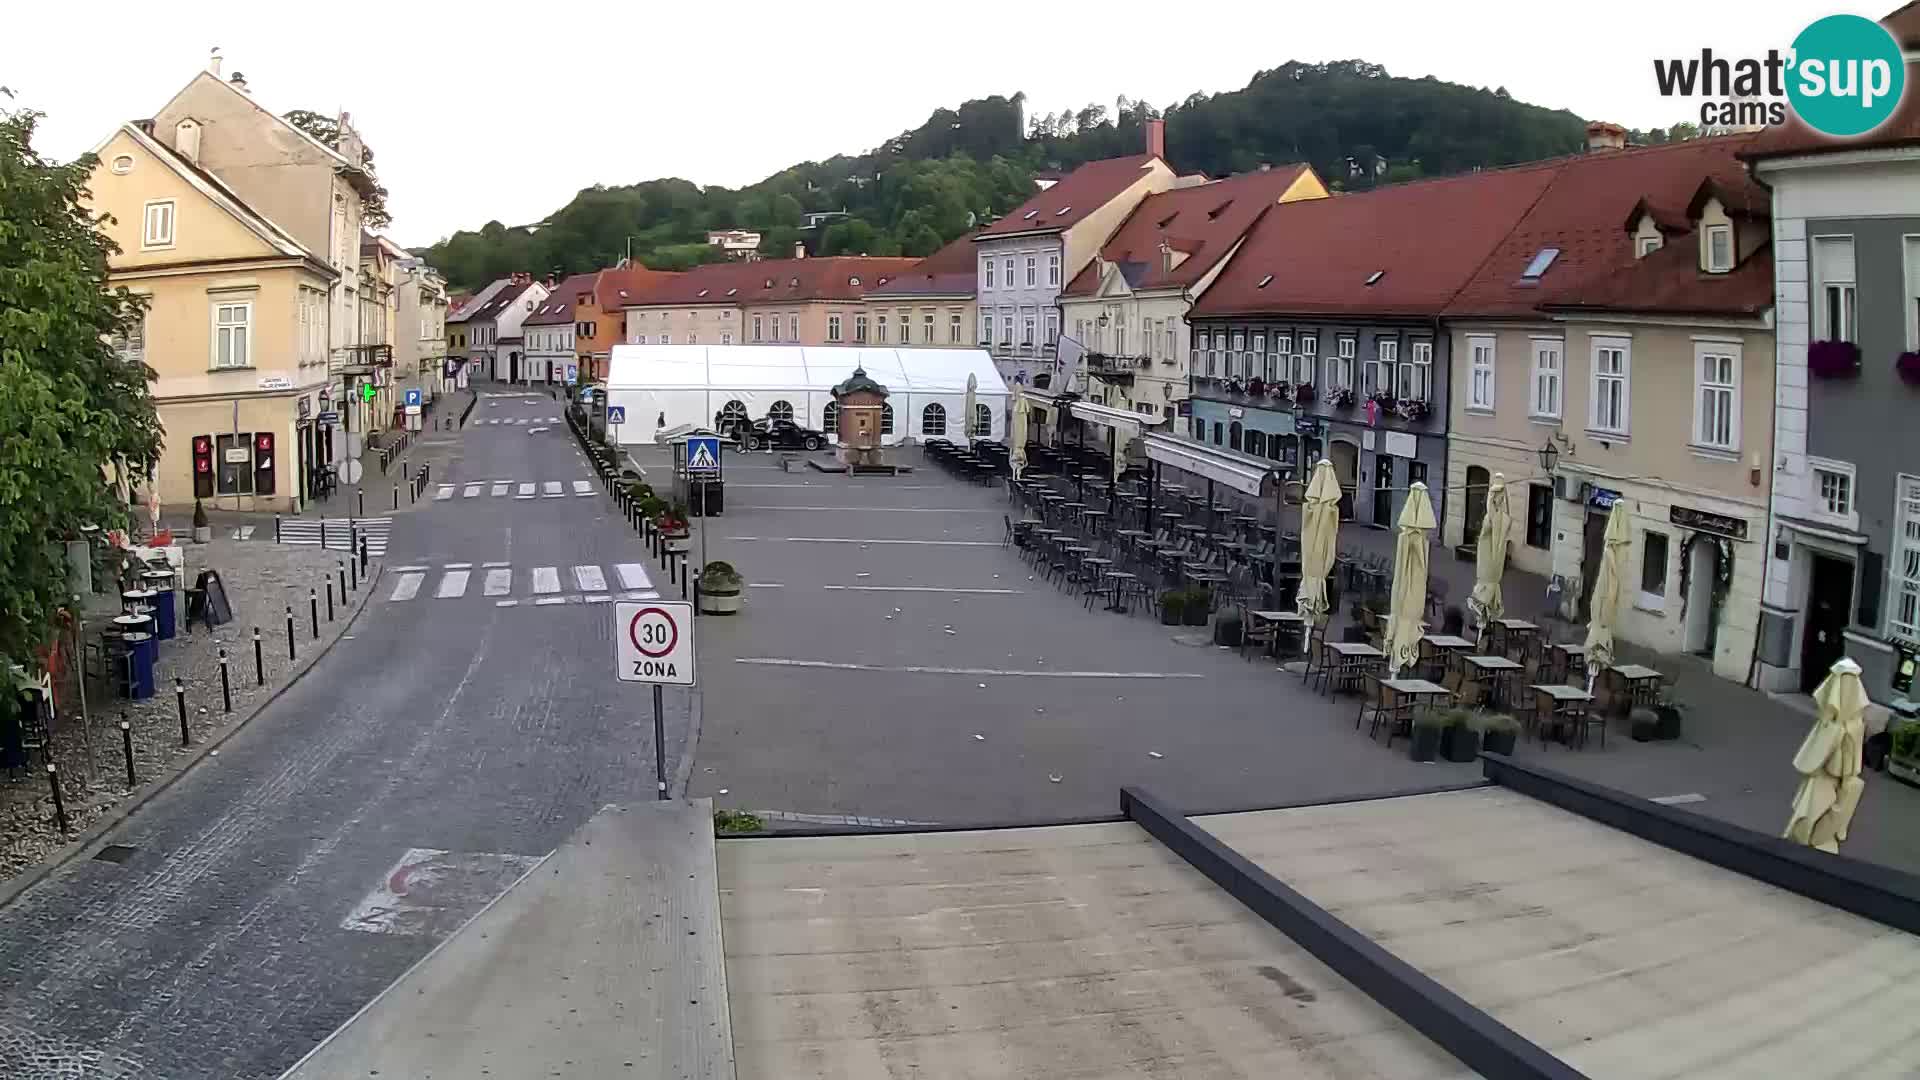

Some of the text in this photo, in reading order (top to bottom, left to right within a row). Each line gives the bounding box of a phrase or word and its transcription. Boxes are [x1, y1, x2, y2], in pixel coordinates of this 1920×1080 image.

[409, 392, 417, 404] P
[642, 623, 666, 644] 30
[633, 660, 677, 677] ZONA
